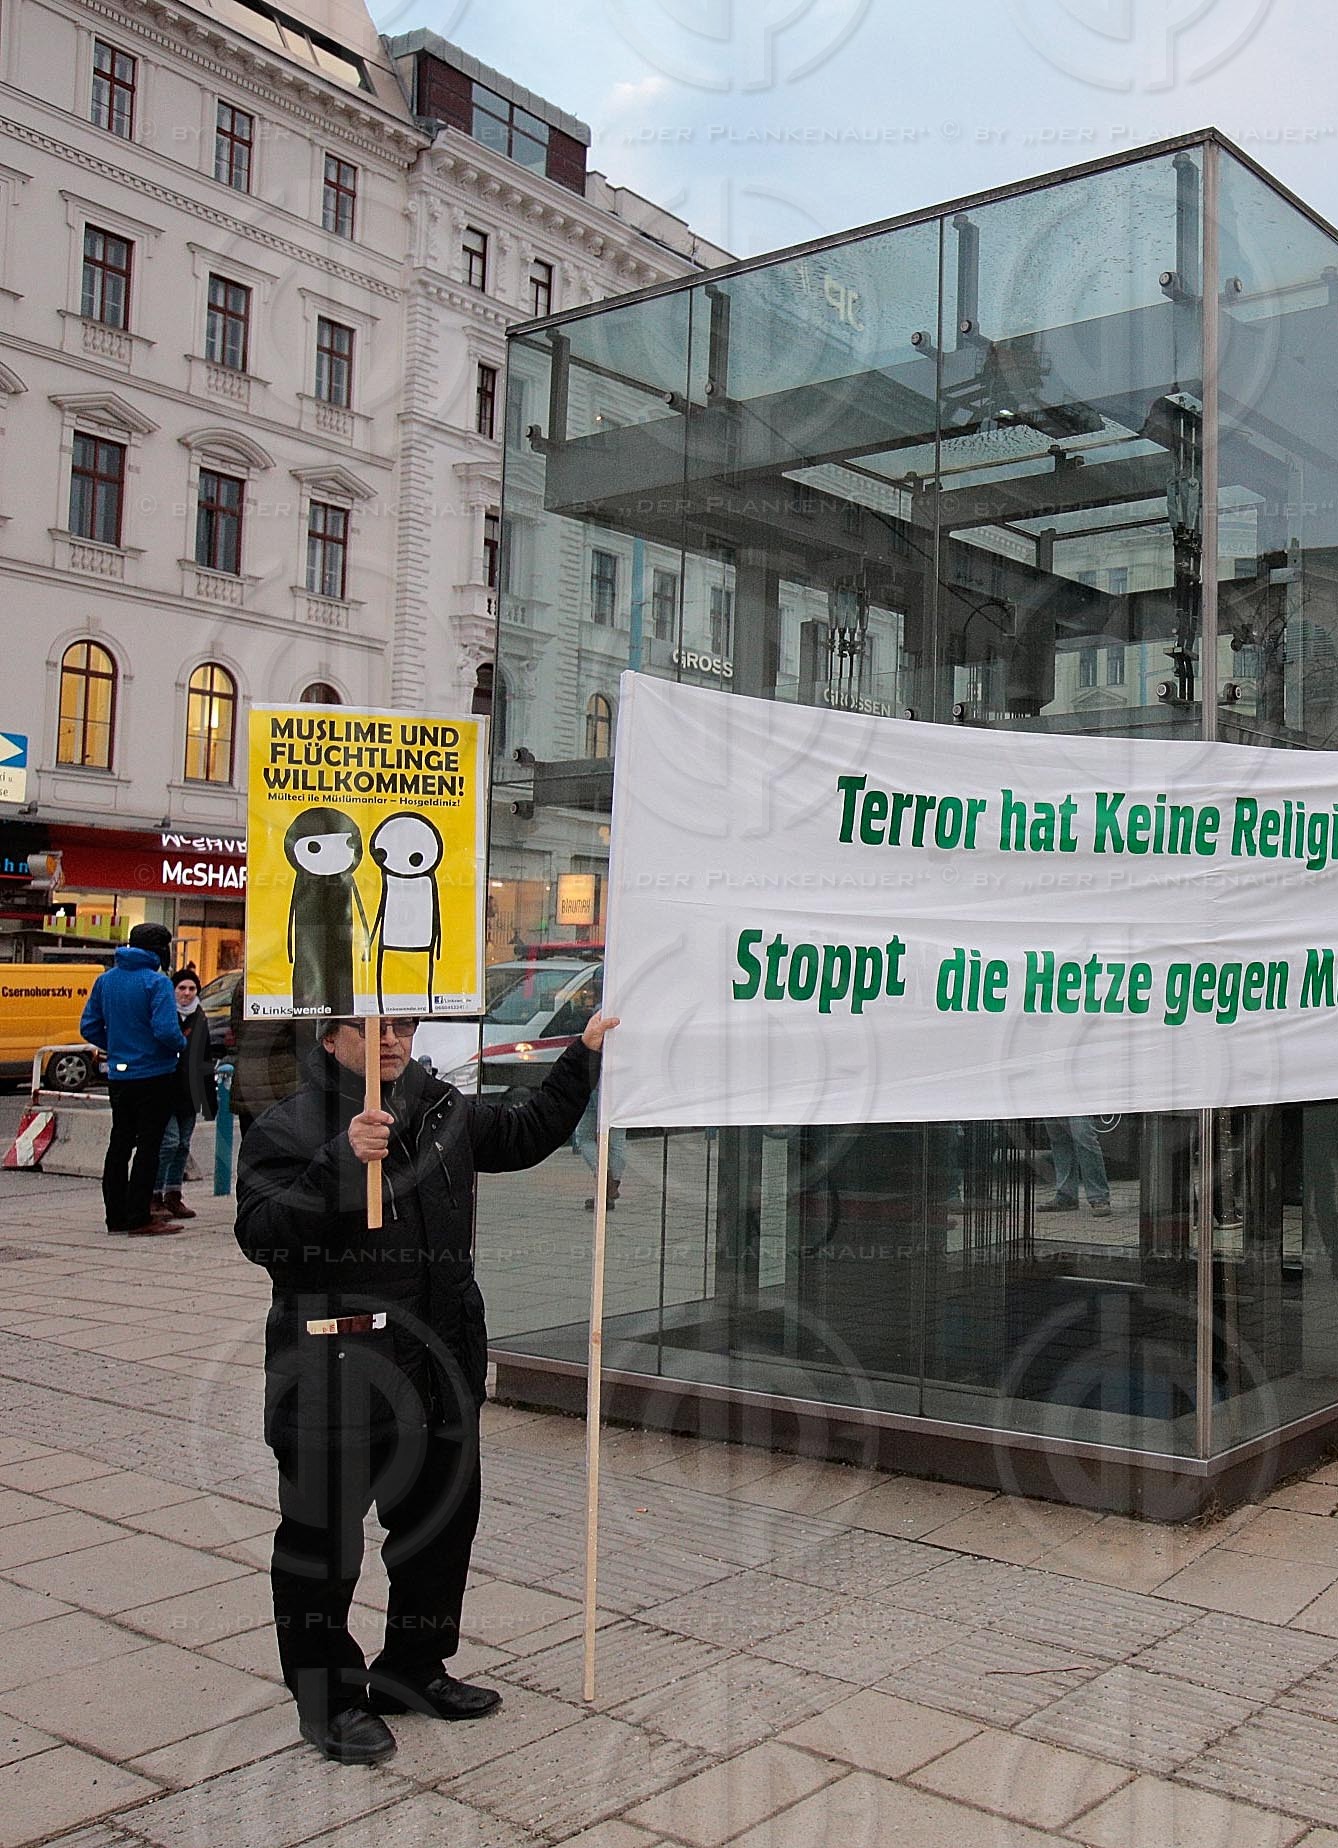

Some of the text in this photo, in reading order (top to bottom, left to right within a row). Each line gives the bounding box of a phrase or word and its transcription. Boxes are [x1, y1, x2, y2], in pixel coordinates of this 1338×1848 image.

[672, 648, 734, 678] GROSS
[270, 717, 460, 747] MUSLIME UND
[270, 742, 460, 772] FLÜCHTLINGE
[263, 767, 465, 797] WILLKOMMEN!
[268, 792, 306, 802] Mülteci
[308, 794, 320, 802] ile
[322, 794, 388, 804] Müslümanlar
[399, 796, 461, 807] Hosgeldiniz!
[837, 773, 986, 850] Terror
[999, 787, 1078, 852] hat
[1094, 790, 1221, 857] Keine
[731, 927, 907, 1015] Stoppt
[935, 946, 1009, 1013] die
[1023, 948, 1153, 1014] Hetze
[1164, 955, 1290, 1026] gegen
[1, 986, 73, 999] Csernohorszky
[262, 1004, 332, 1015] Linkswende
